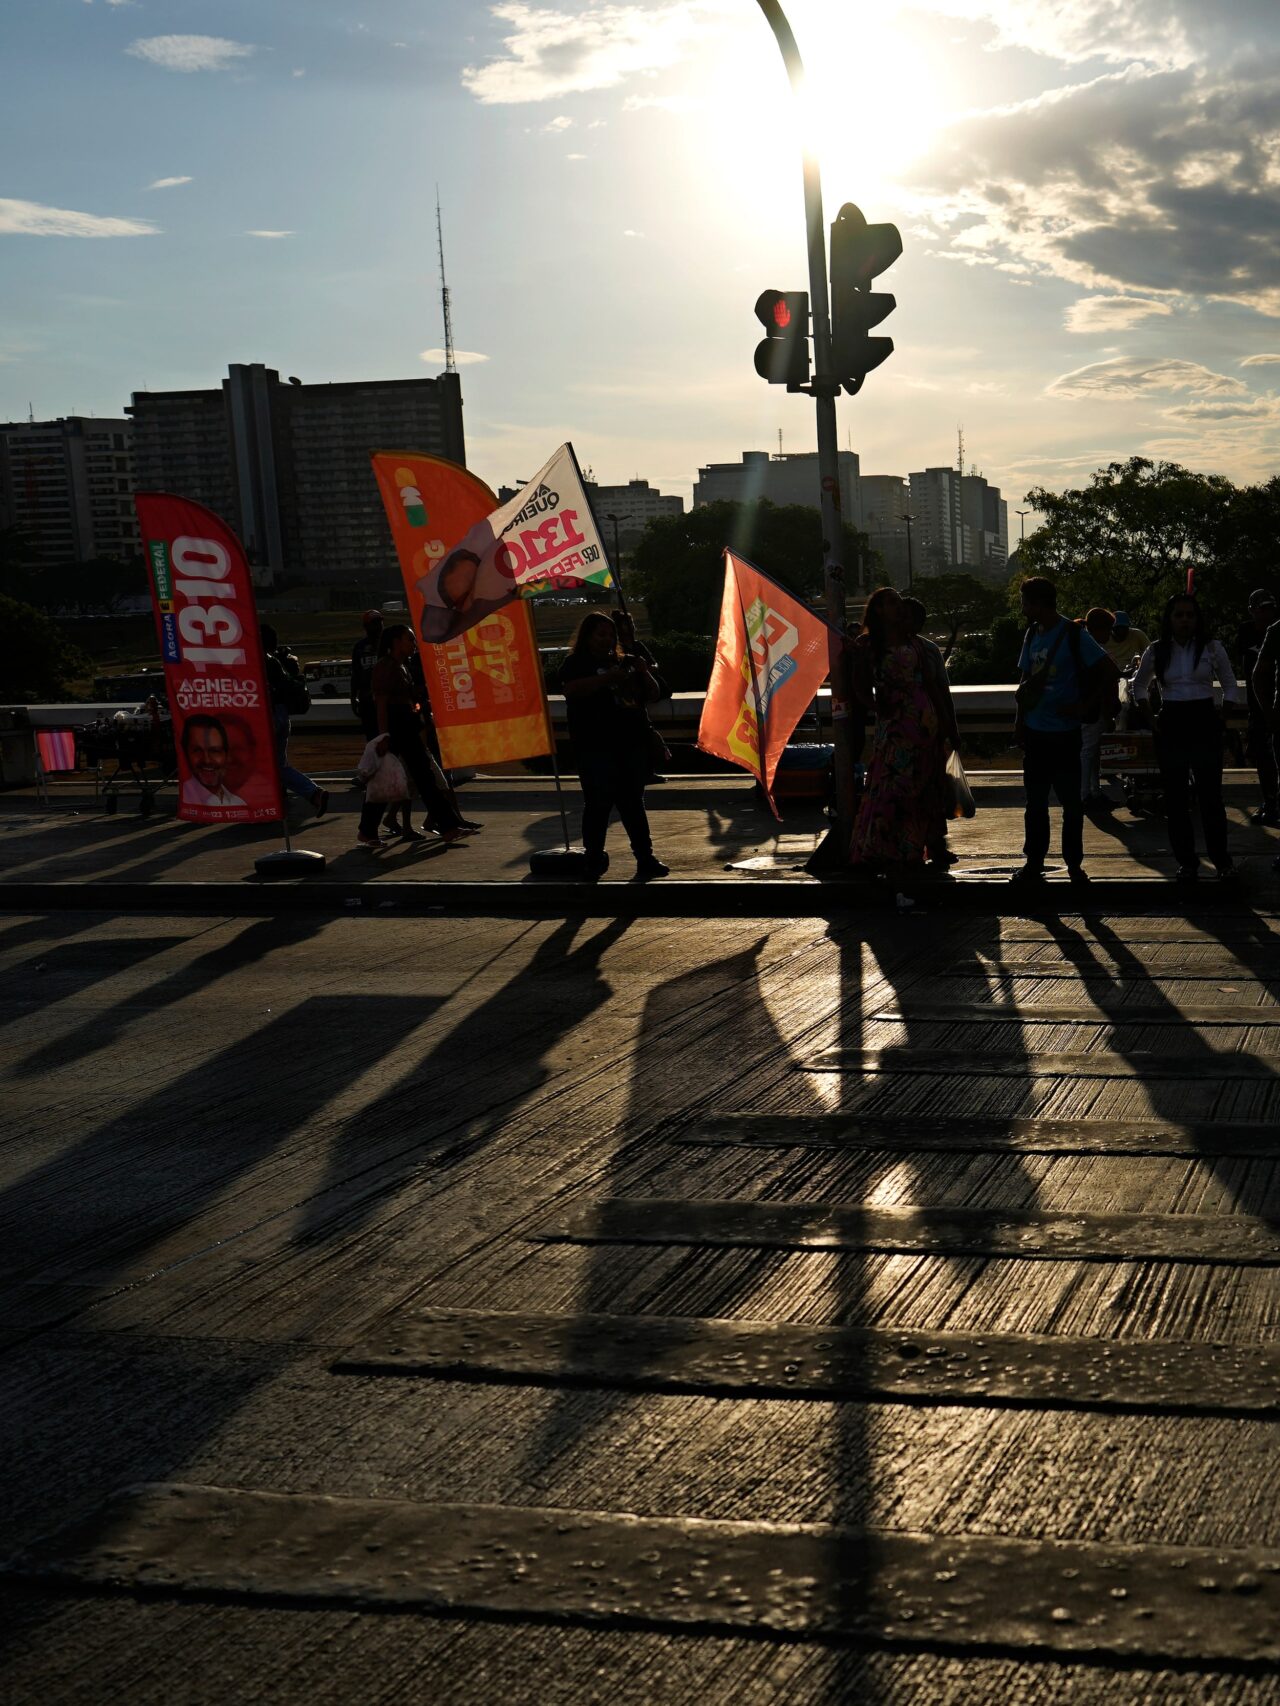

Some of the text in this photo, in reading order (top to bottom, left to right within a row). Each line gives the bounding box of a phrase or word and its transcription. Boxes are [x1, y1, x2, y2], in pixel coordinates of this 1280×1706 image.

[152, 542, 169, 599] FEDERAL
[172, 535, 246, 672] 1310
[164, 614, 178, 659] AGORA
[176, 693, 260, 710] QUEIROZ
[179, 679, 257, 693] AGNELO
[435, 658, 456, 712] DEPUTADO
